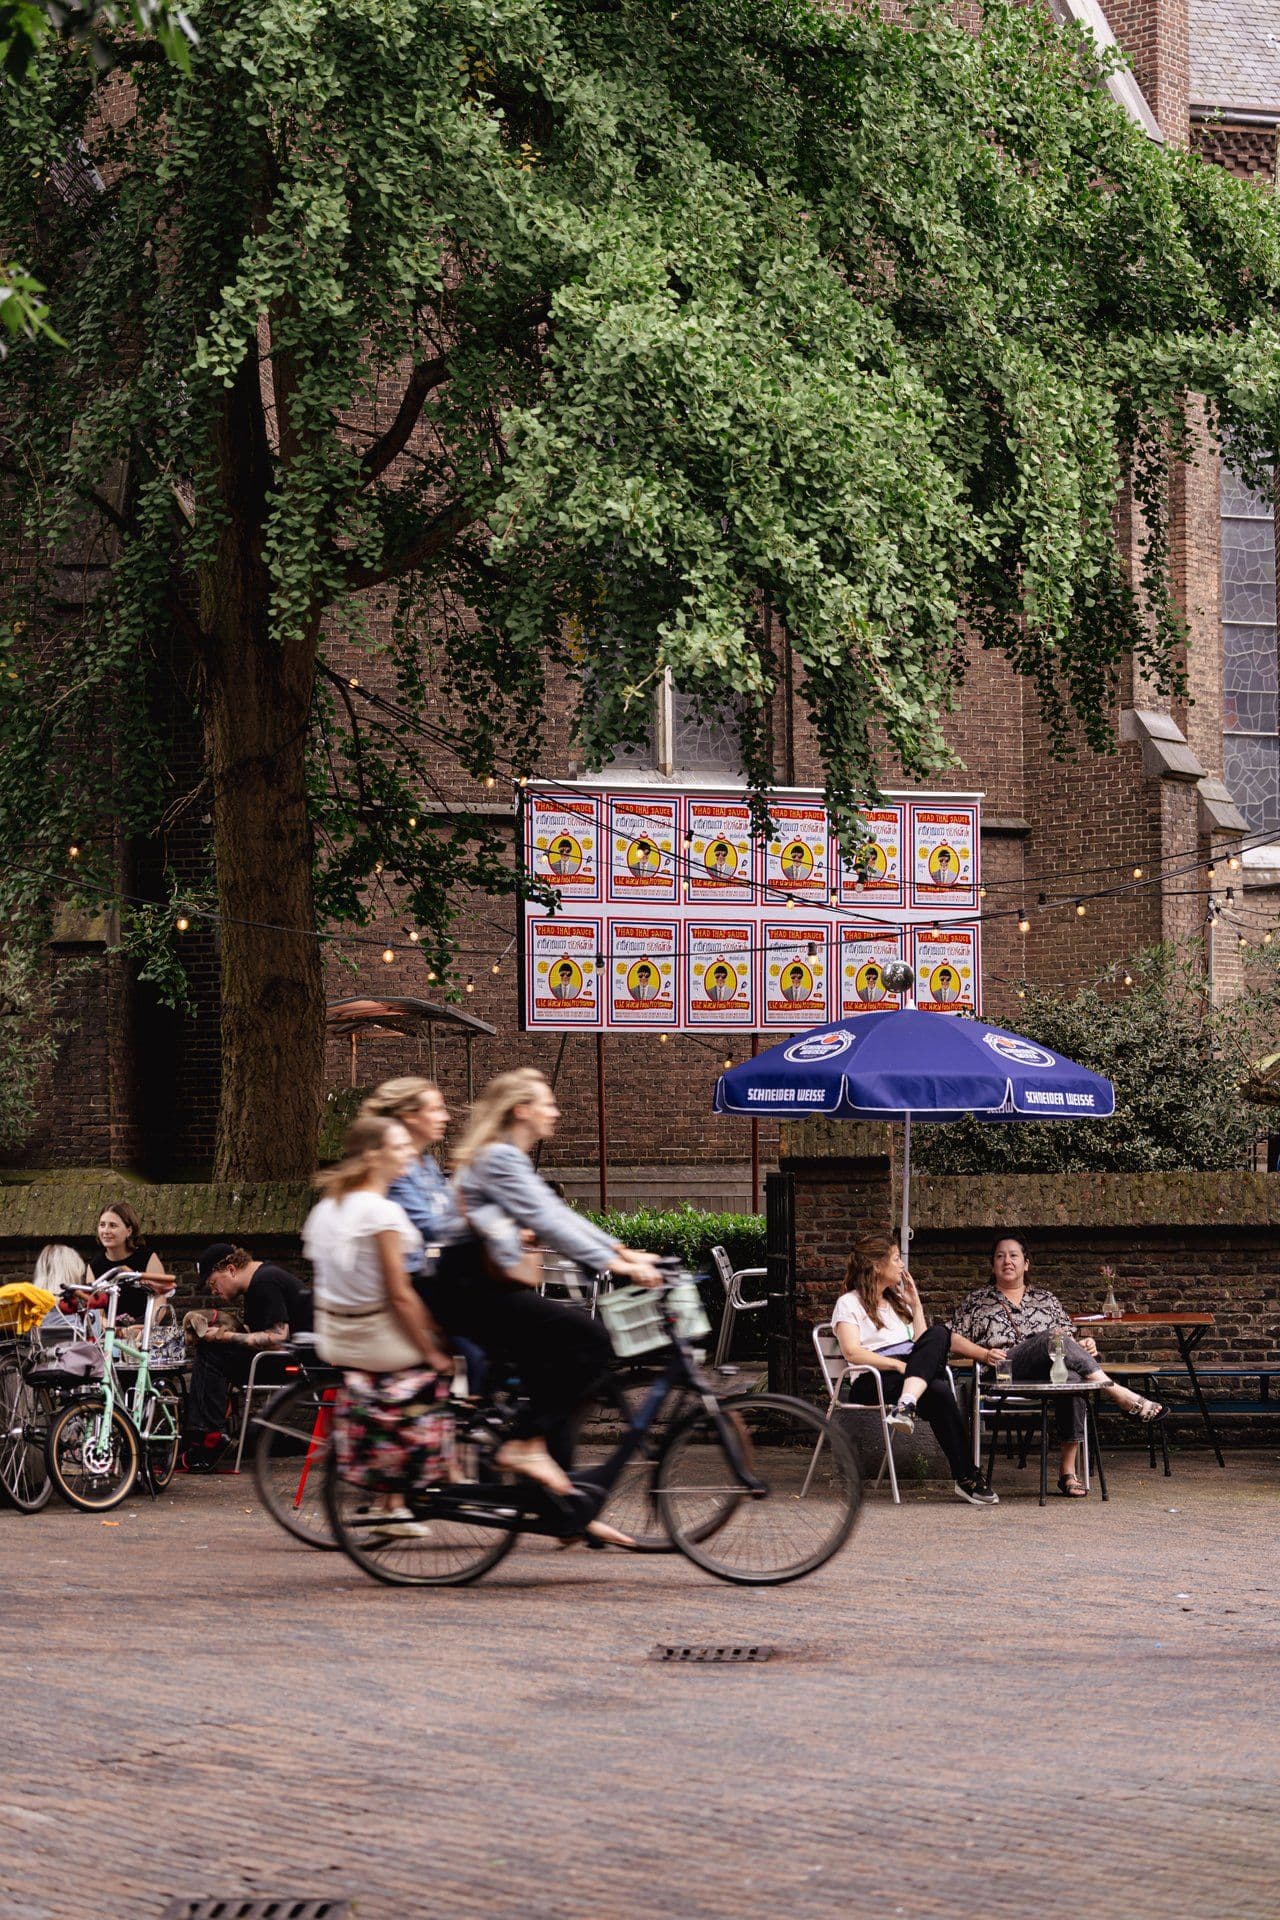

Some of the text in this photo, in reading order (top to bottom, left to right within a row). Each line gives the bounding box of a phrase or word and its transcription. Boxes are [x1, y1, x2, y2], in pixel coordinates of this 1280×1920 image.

[747, 1088, 825, 1102] SCHNEIDER WEISSE
[1025, 1091, 1095, 1107] SCHNEIDER WEISSE
